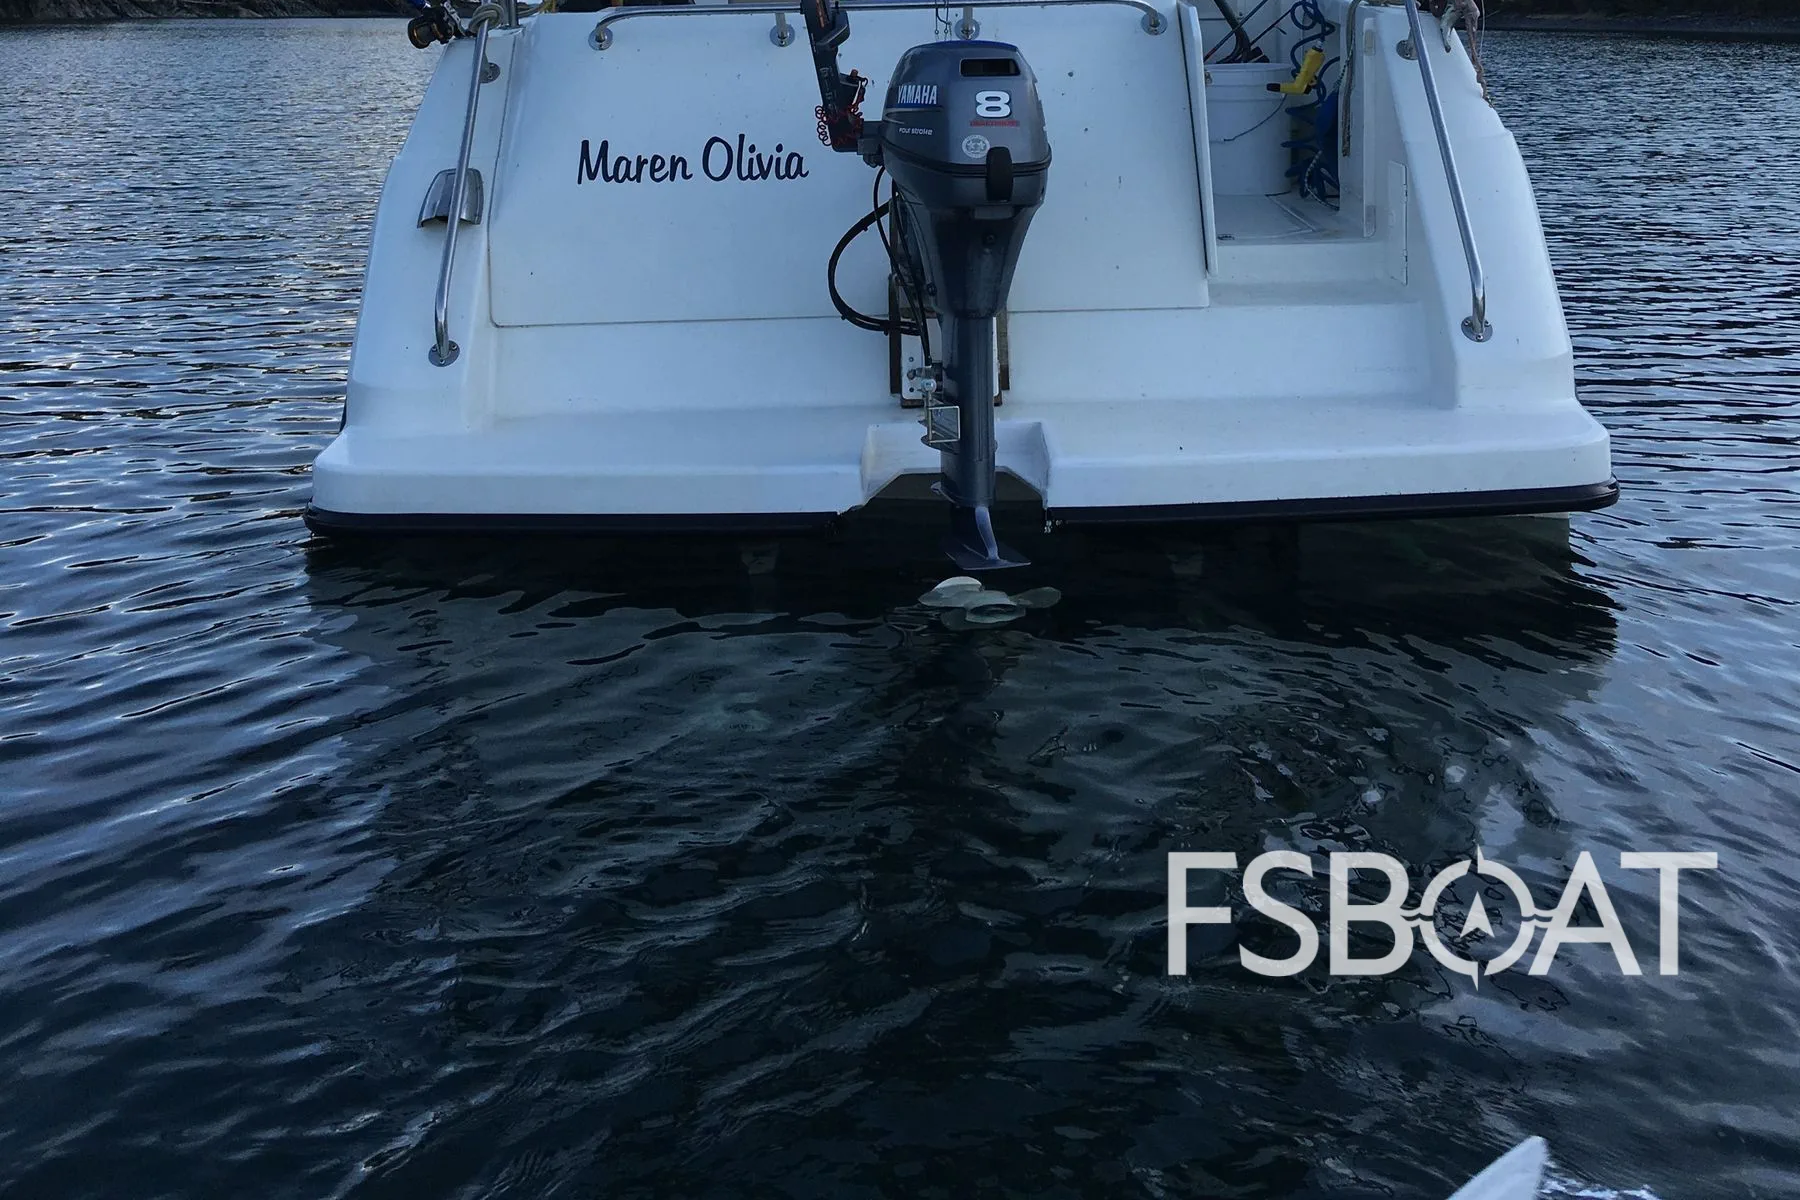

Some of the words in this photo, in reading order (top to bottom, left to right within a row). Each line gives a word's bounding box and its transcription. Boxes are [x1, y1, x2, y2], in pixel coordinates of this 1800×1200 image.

[898, 85, 938, 104] YAMAHA
[975, 90, 1011, 118] 8
[577, 139, 693, 185] Maren
[702, 133, 809, 182] Olivia
